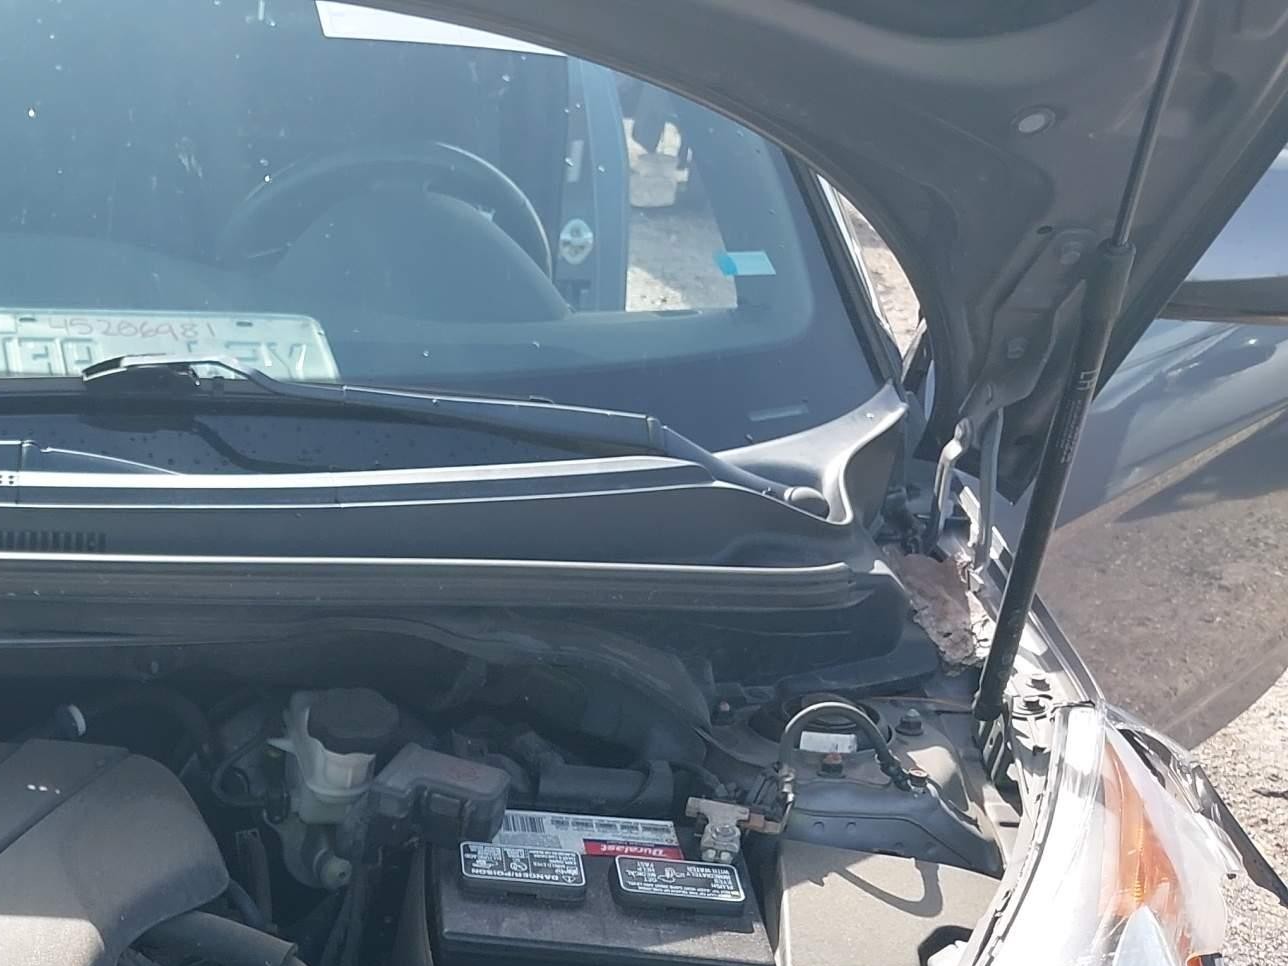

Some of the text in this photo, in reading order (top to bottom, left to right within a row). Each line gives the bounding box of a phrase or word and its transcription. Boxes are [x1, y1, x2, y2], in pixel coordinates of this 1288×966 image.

[48, 317, 217, 341] 45206981
[600, 844, 664, 856] Duralast
[471, 868, 559, 881] DANGER/POISON
